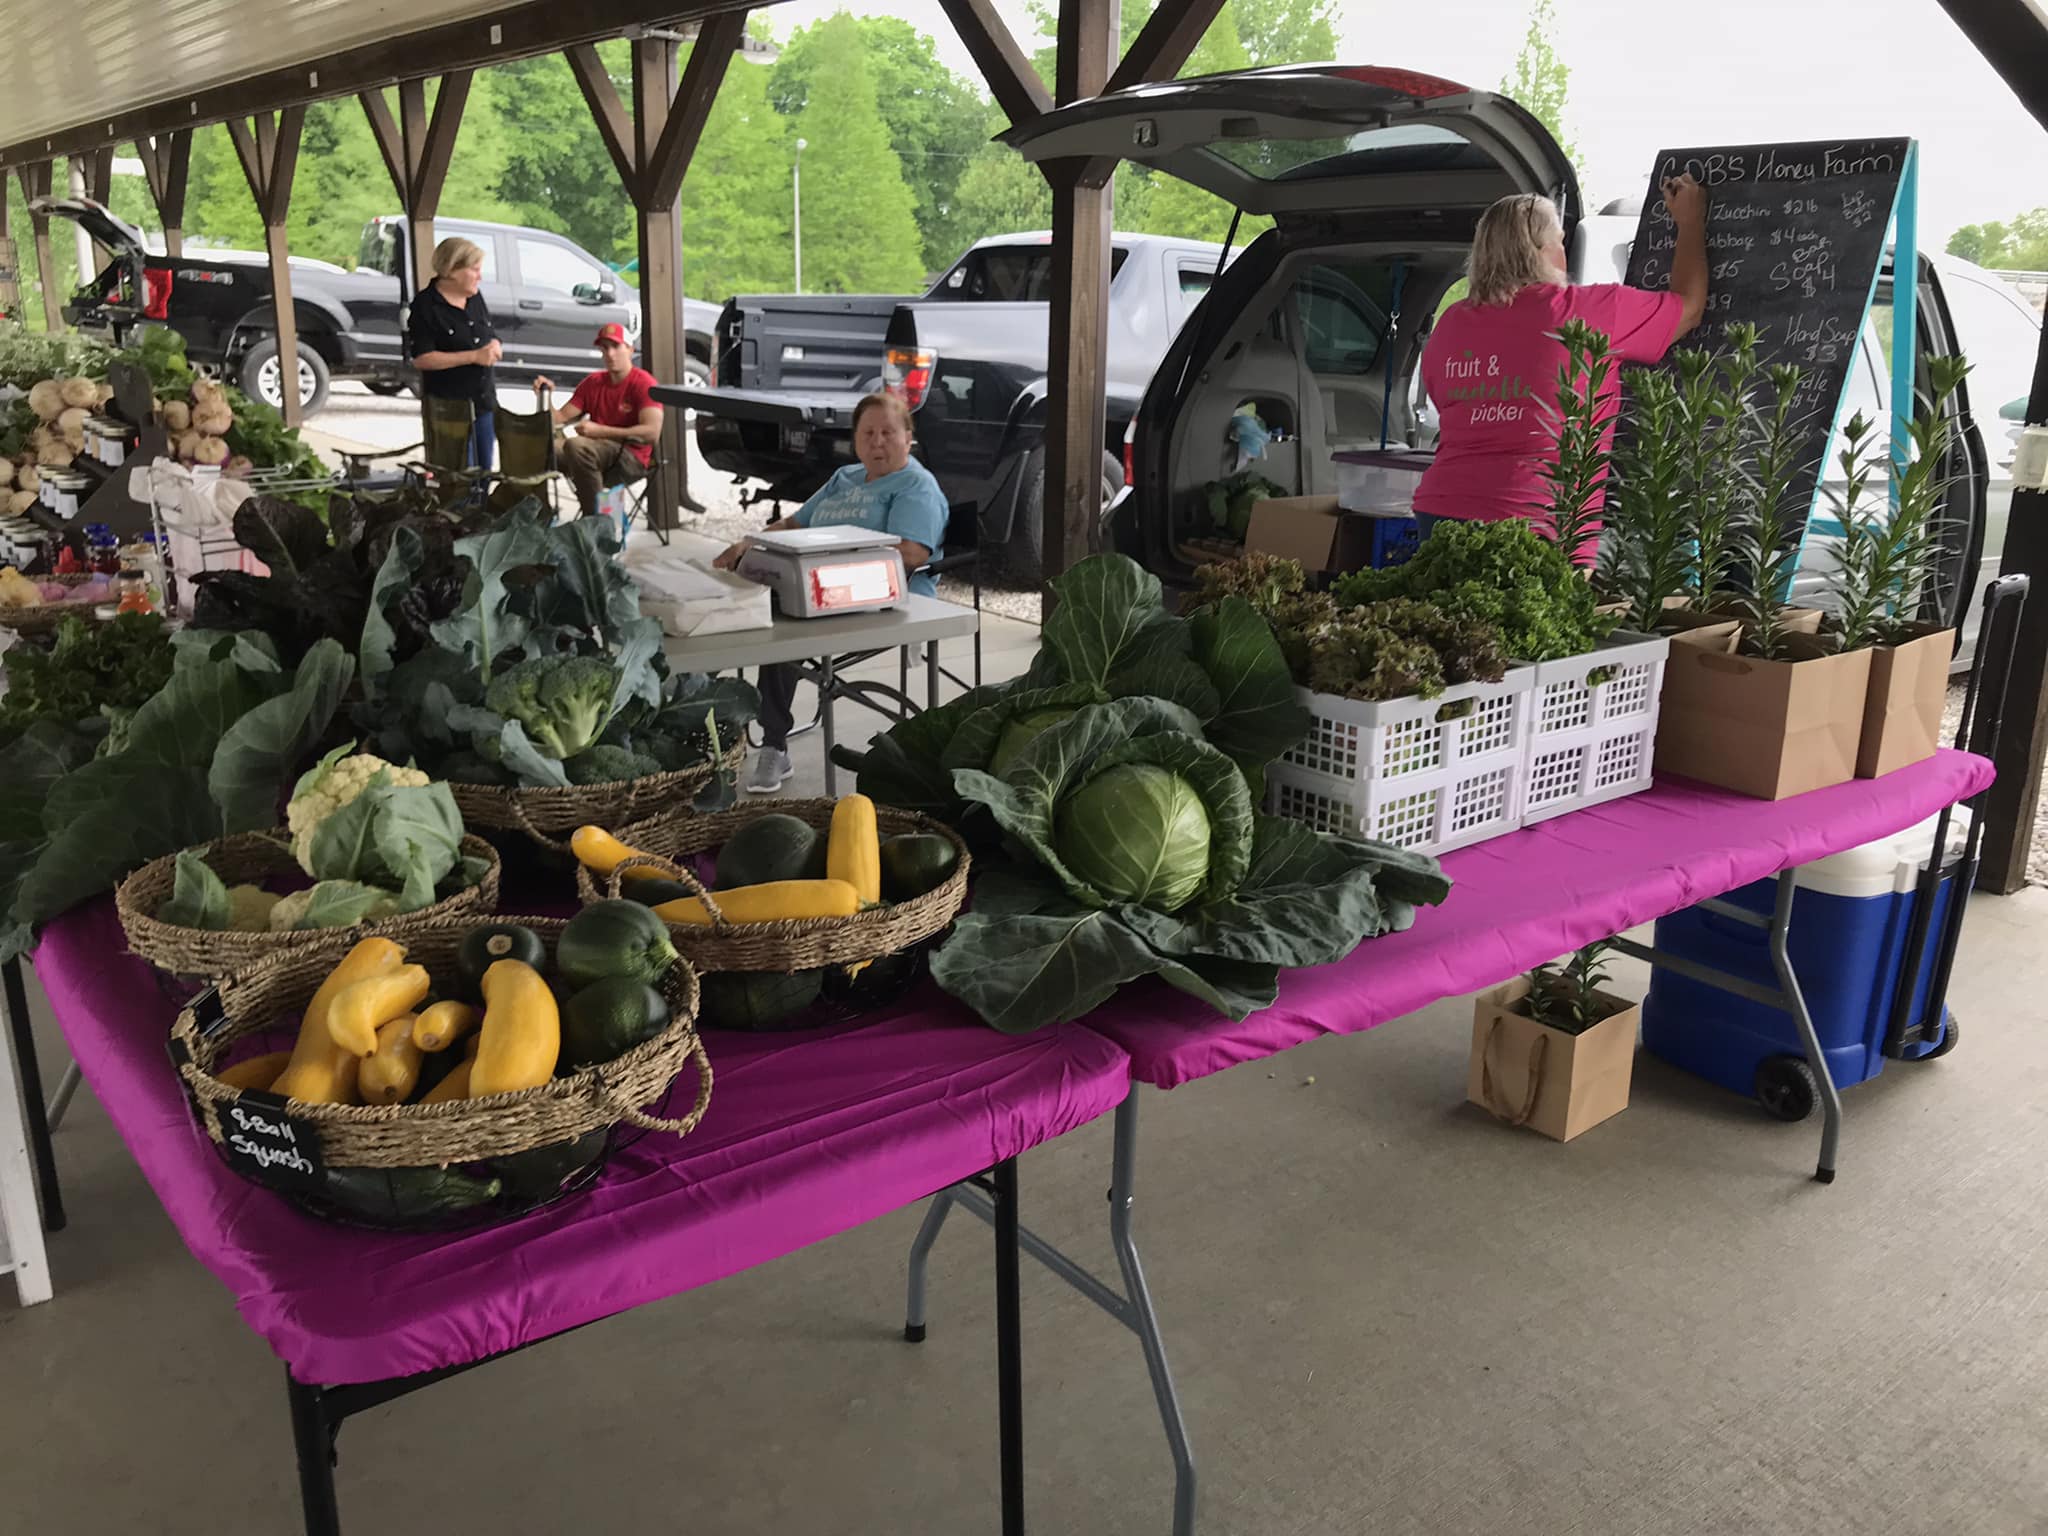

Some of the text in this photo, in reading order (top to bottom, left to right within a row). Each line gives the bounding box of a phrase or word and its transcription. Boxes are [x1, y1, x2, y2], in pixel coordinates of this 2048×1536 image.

[1754, 149, 1815, 184] Honey
[1824, 144, 1893, 177] Farm
[1713, 259, 1745, 280] $5
[1769, 251, 1829, 291] Soap
[1802, 343, 1837, 362] $3
[1445, 354, 1500, 378] fruit &
[1470, 402, 1525, 425] picker
[229, 1134, 314, 1175] Squash
